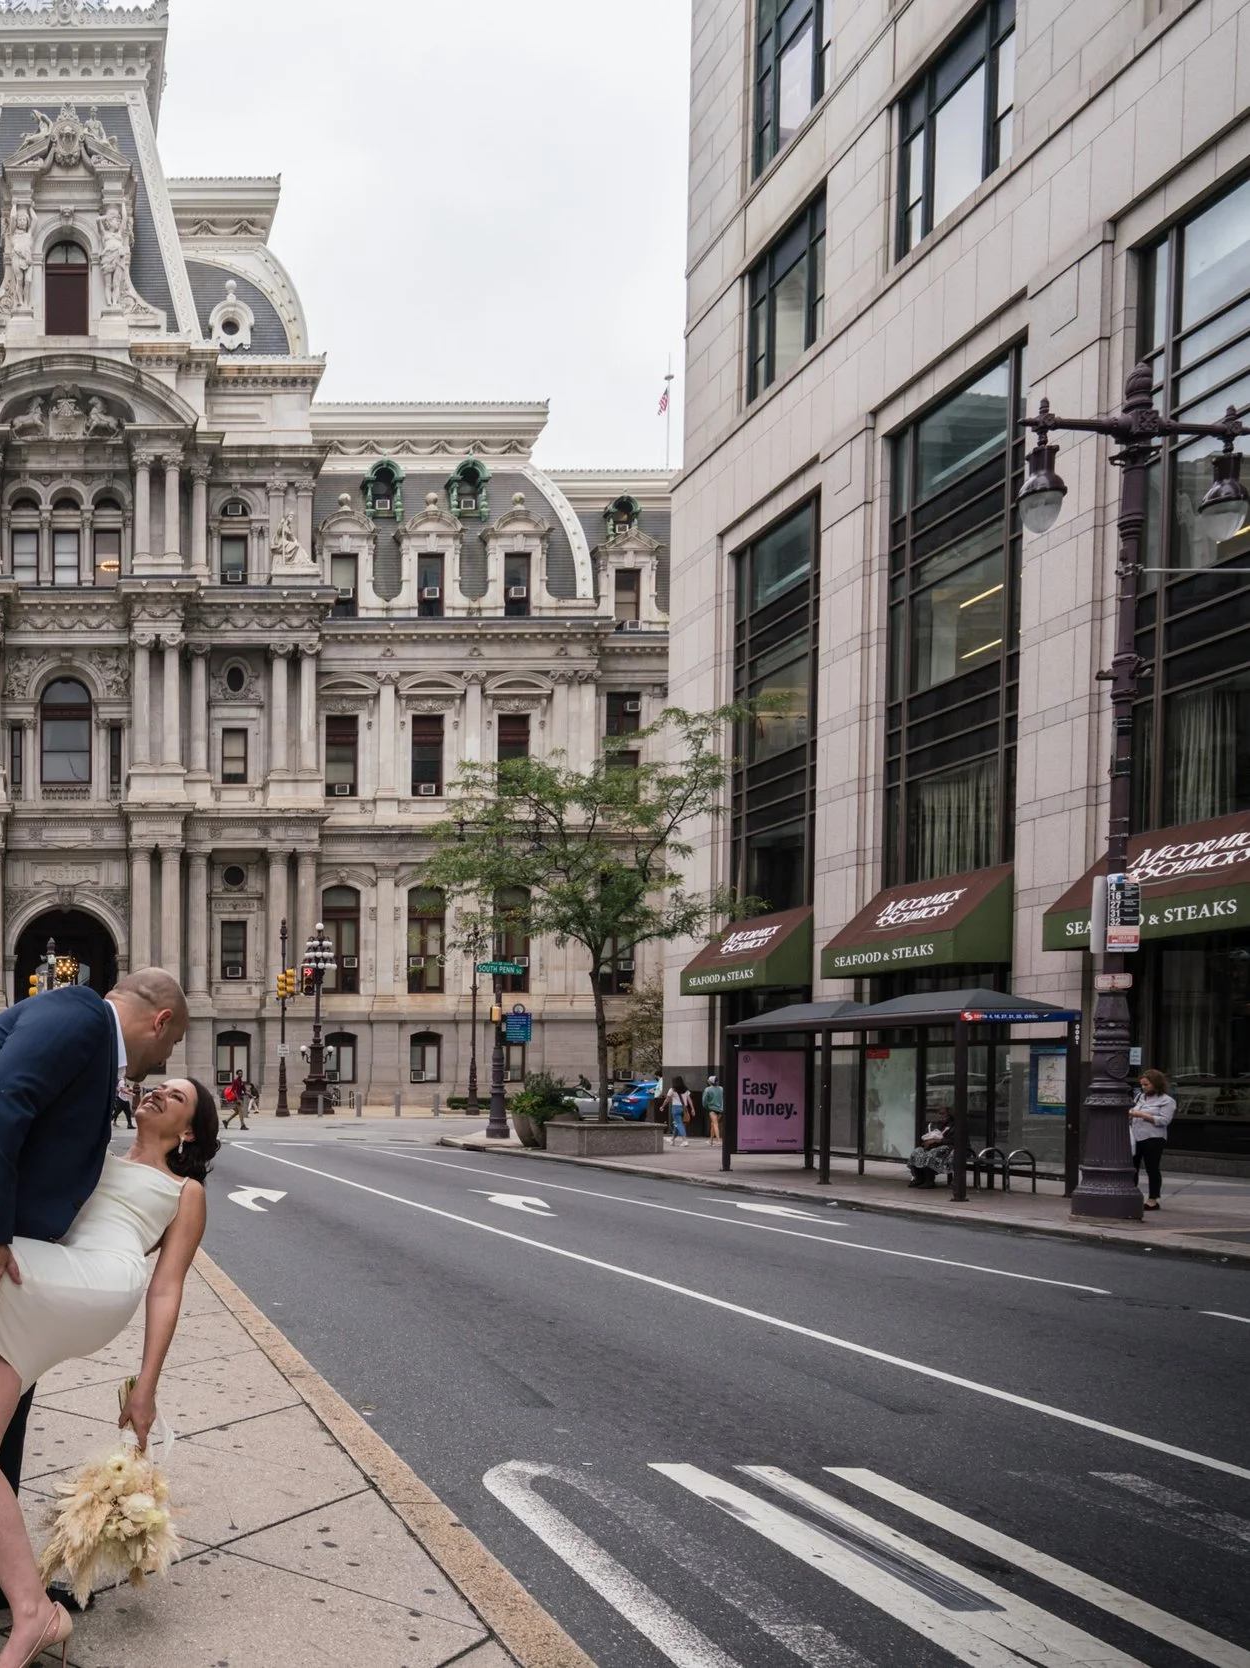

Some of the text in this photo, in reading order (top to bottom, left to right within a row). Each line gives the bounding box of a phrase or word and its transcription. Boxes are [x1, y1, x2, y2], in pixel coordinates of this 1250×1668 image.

[41, 869, 90, 879] JUSTICE
[1110, 883, 1116, 891] 4
[1110, 892, 1122, 900] 16
[1110, 901, 1121, 909] 27
[1110, 909, 1120, 917] 31
[1148, 899, 1238, 925] & STEAKS
[1110, 918, 1121, 926] 32
[834, 943, 934, 967] SEAFOOD & STEAKS
[478, 964, 498, 973] SOUTH
[499, 966, 515, 974] PENN
[689, 974, 721, 987] SEAFOOD
[727, 968, 754, 982] STEAKS
[742, 1078, 777, 1099] Easy
[741, 1098, 798, 1120] Money.
